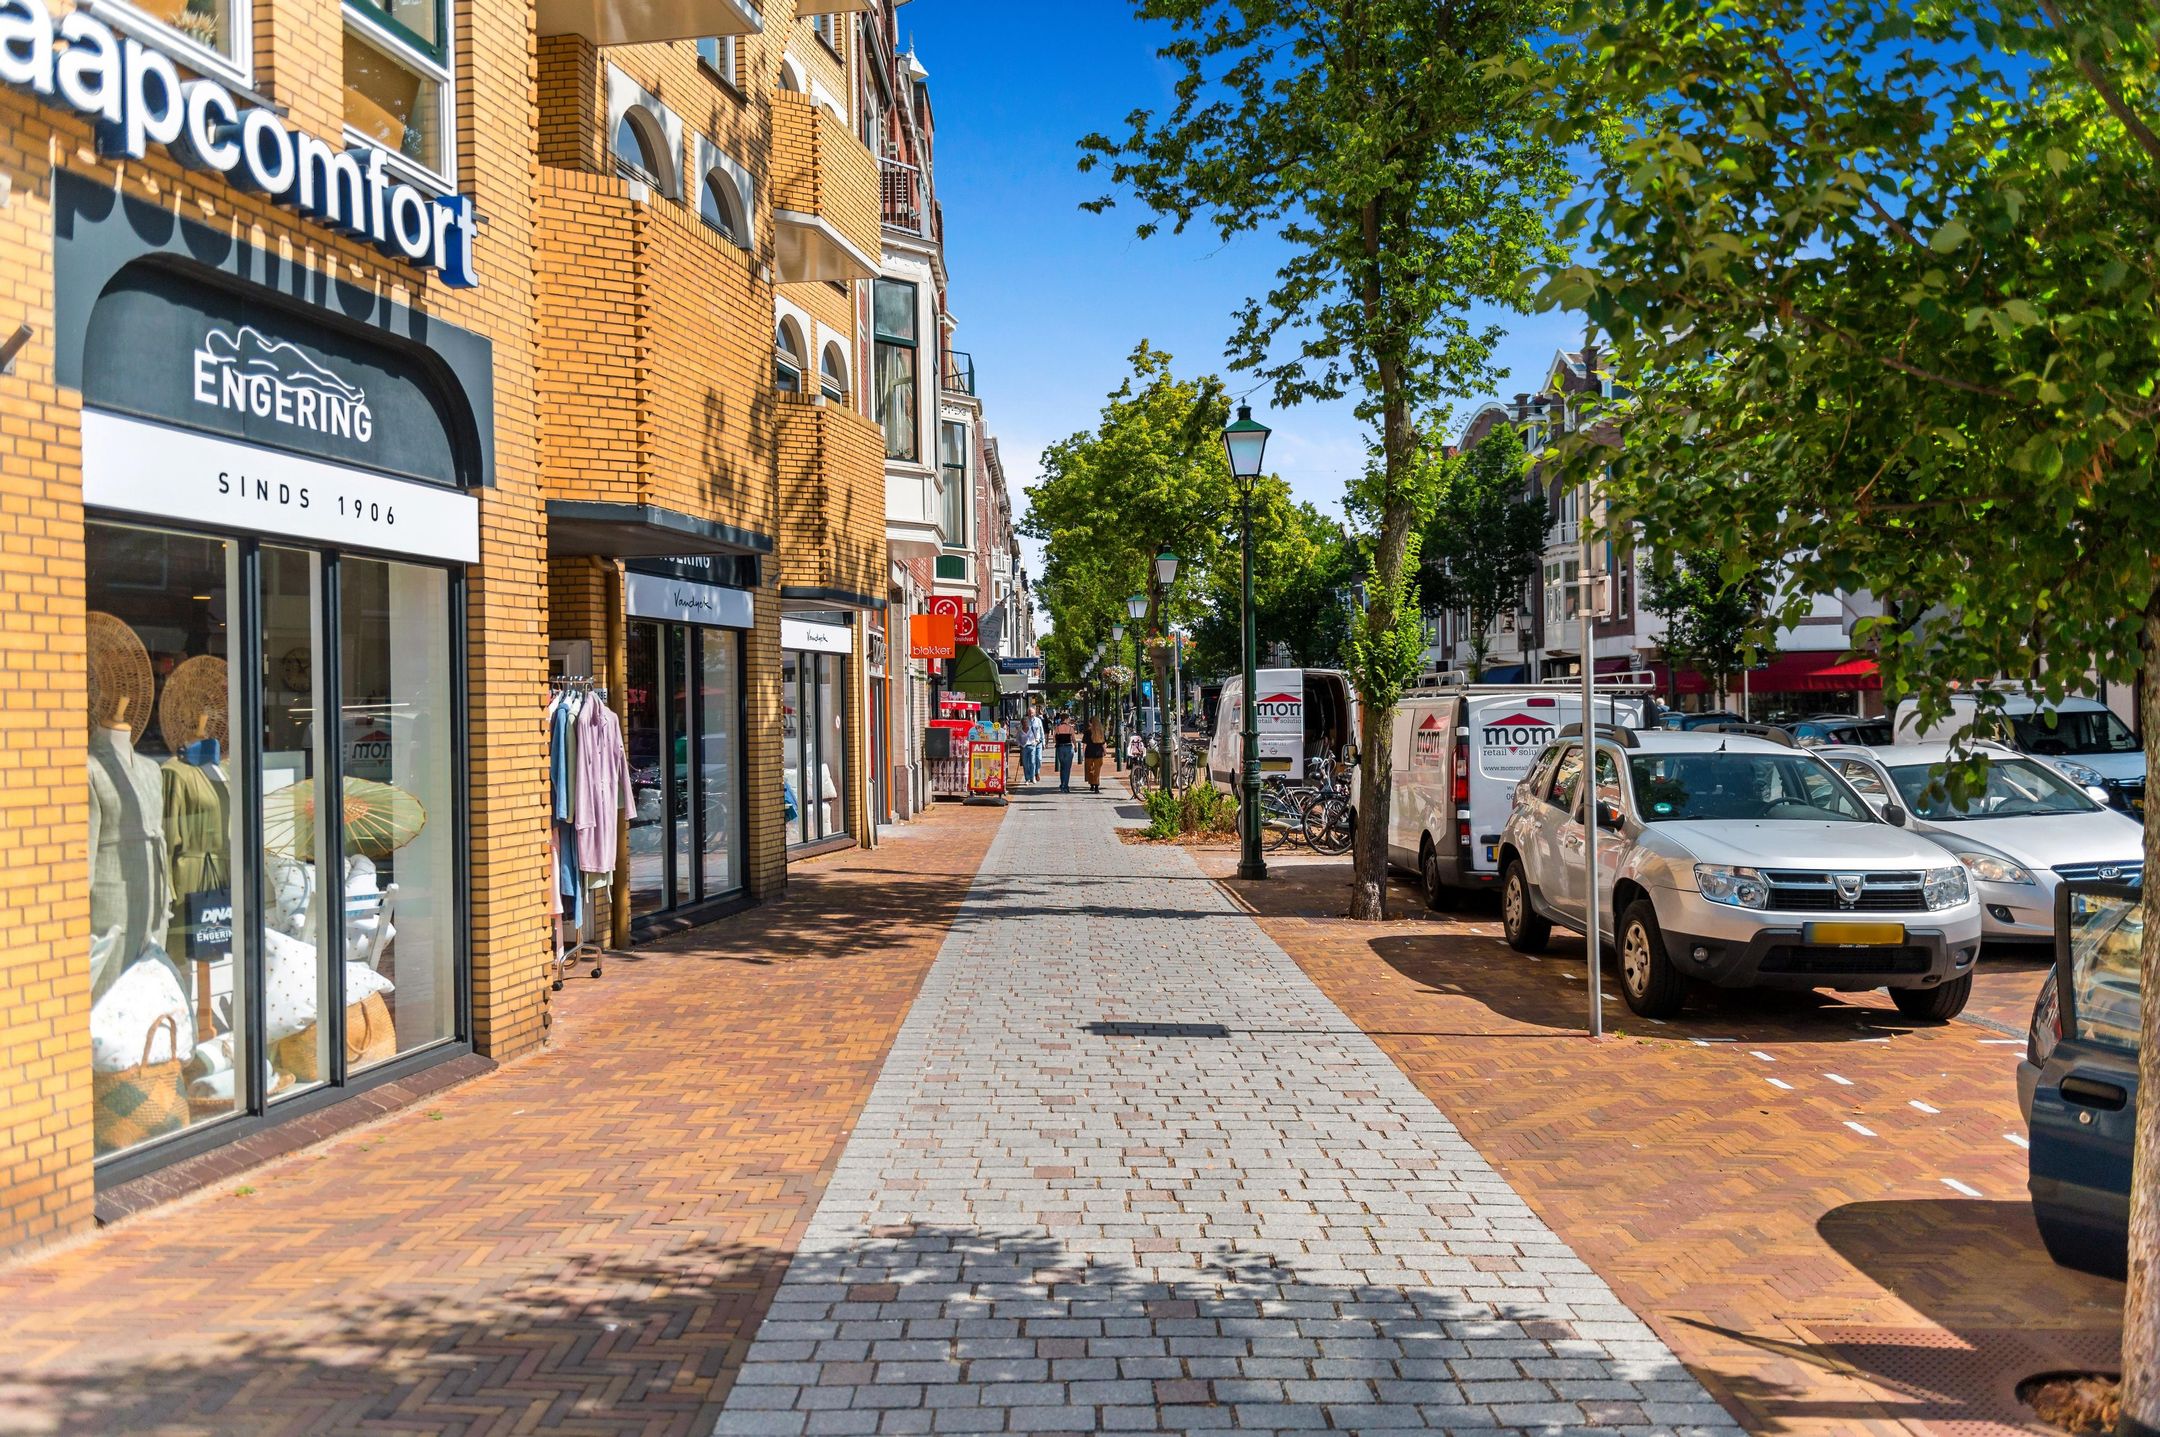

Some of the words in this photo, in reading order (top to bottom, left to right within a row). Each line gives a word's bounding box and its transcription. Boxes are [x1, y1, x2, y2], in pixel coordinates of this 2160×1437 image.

[194, 348, 372, 442] ENGERING
[218, 471, 310, 508] SINDS
[338, 496, 395, 524] 1906
[1416, 731, 1440, 753] mom
[1483, 727, 1556, 746] mom
[974, 744, 1001, 752] ACTIE!
[1483, 748, 1506, 756] retail
